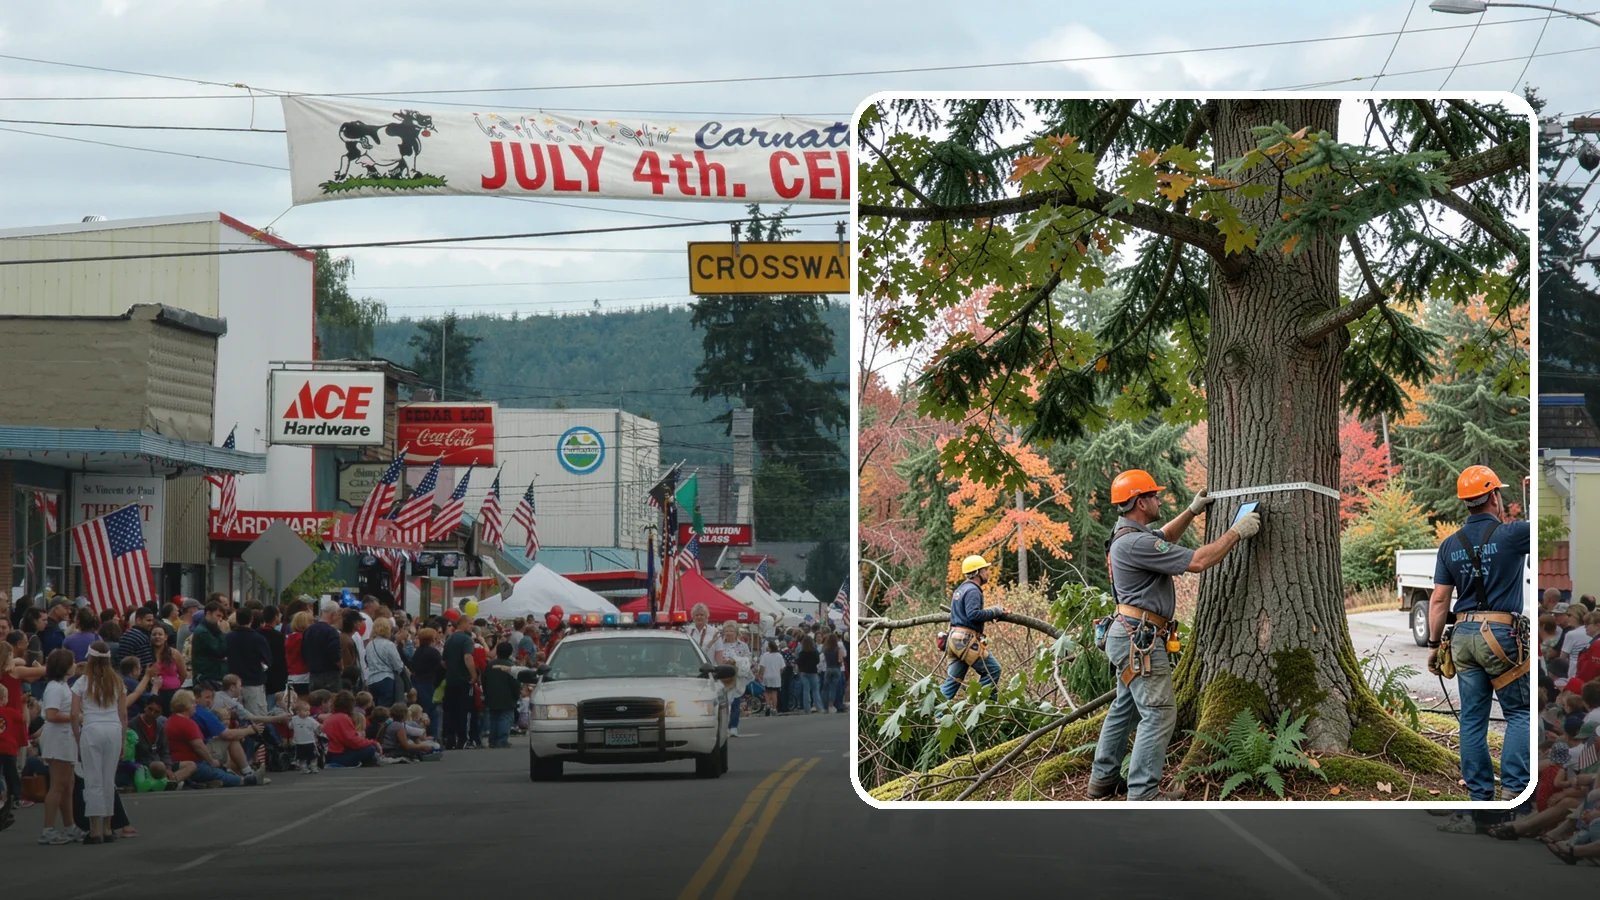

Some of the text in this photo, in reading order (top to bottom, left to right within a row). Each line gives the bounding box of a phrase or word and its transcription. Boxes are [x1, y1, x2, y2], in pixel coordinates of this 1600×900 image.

[695, 121, 850, 150] Carnat
[481, 140, 605, 192] JULY
[632, 150, 747, 197] 4th.
[697, 254, 850, 280] CROSSWA
[283, 380, 373, 420] ACE
[283, 421, 371, 436] Hardware
[416, 428, 477, 447] Coca-Cola
[96, 485, 124, 495] Vincent
[126, 486, 136, 495] de
[137, 486, 155, 496] Paul
[688, 526, 741, 535] CRNATION
[699, 535, 730, 543] GLASS
